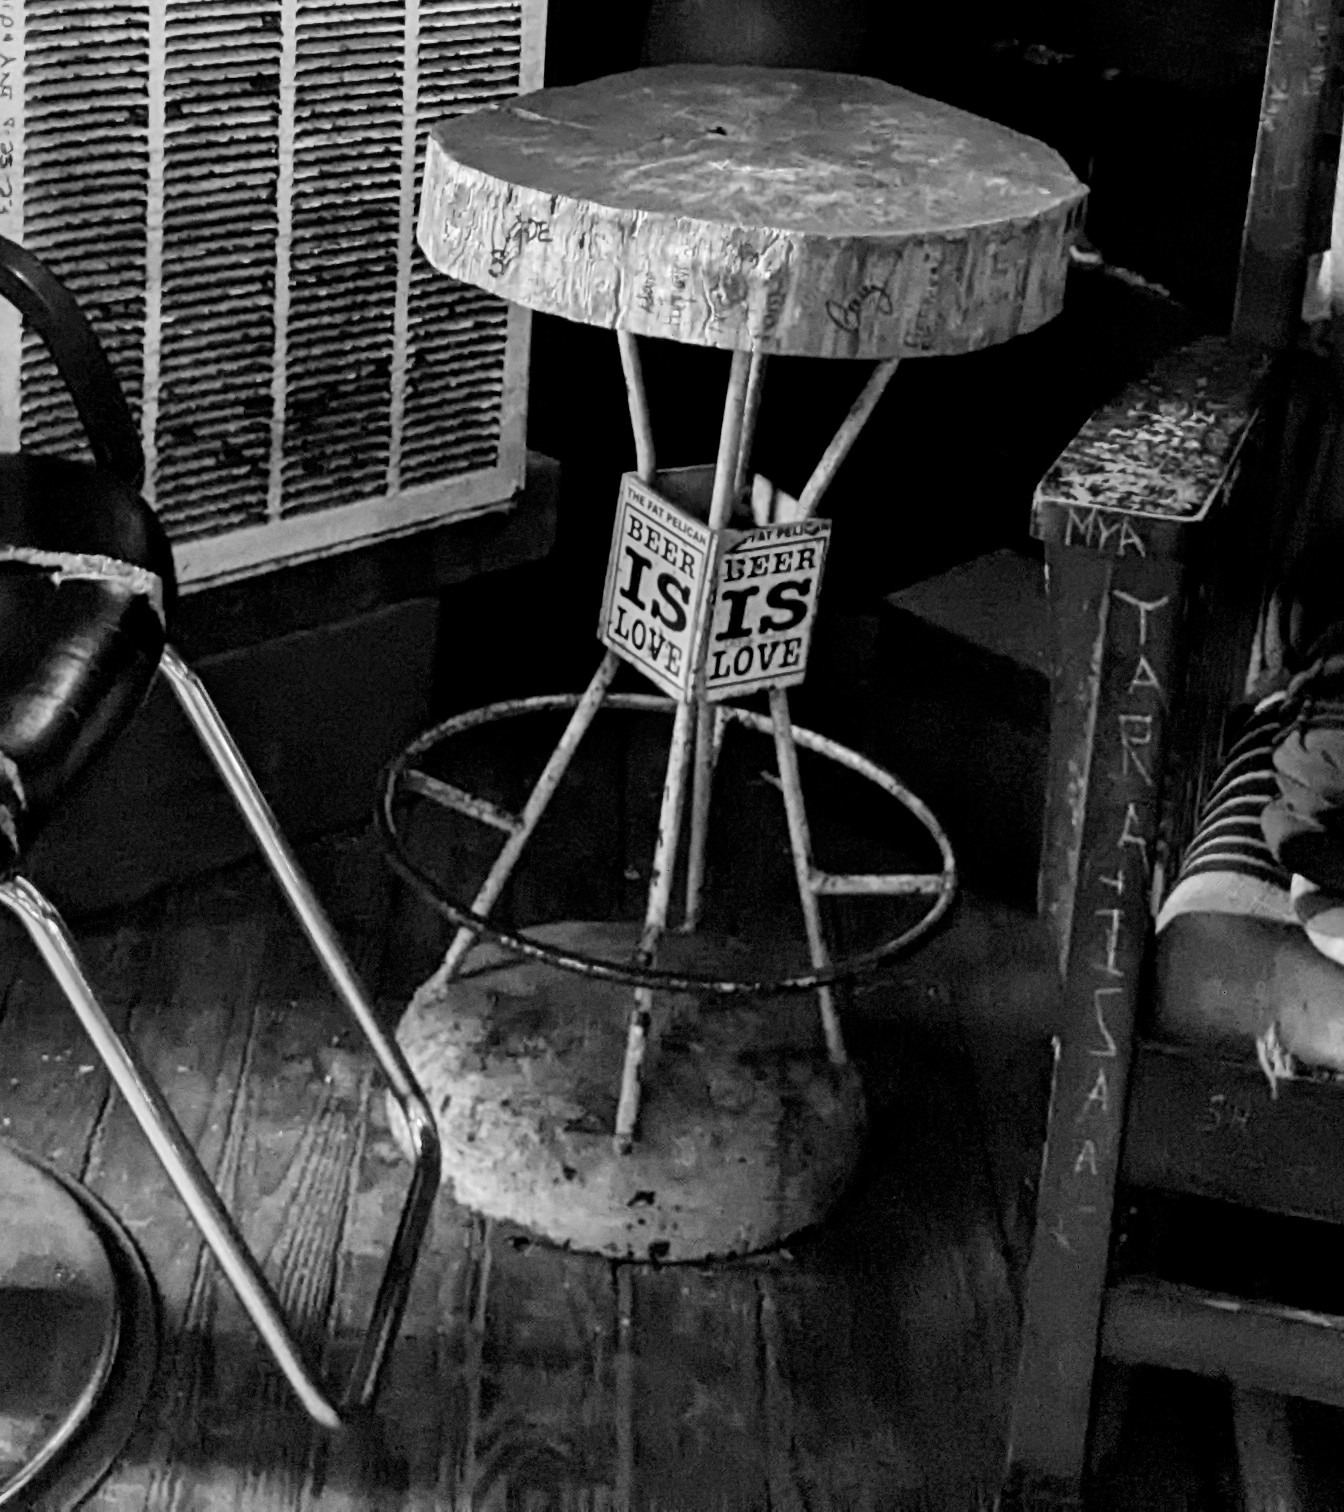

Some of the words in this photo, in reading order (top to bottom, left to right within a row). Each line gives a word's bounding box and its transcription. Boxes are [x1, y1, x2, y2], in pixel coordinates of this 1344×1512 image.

[626, 487, 646, 508] THE
[647, 498, 665, 519] FAT
[666, 510, 706, 545] PELICAN
[1065, 507, 1147, 559] MYA
[626, 514, 696, 580] BEER
[723, 547, 817, 583] BEER
[620, 546, 691, 633] IS
[715, 578, 812, 641] IS
[614, 606, 683, 678] LOVE
[709, 637, 803, 680] LOVE
